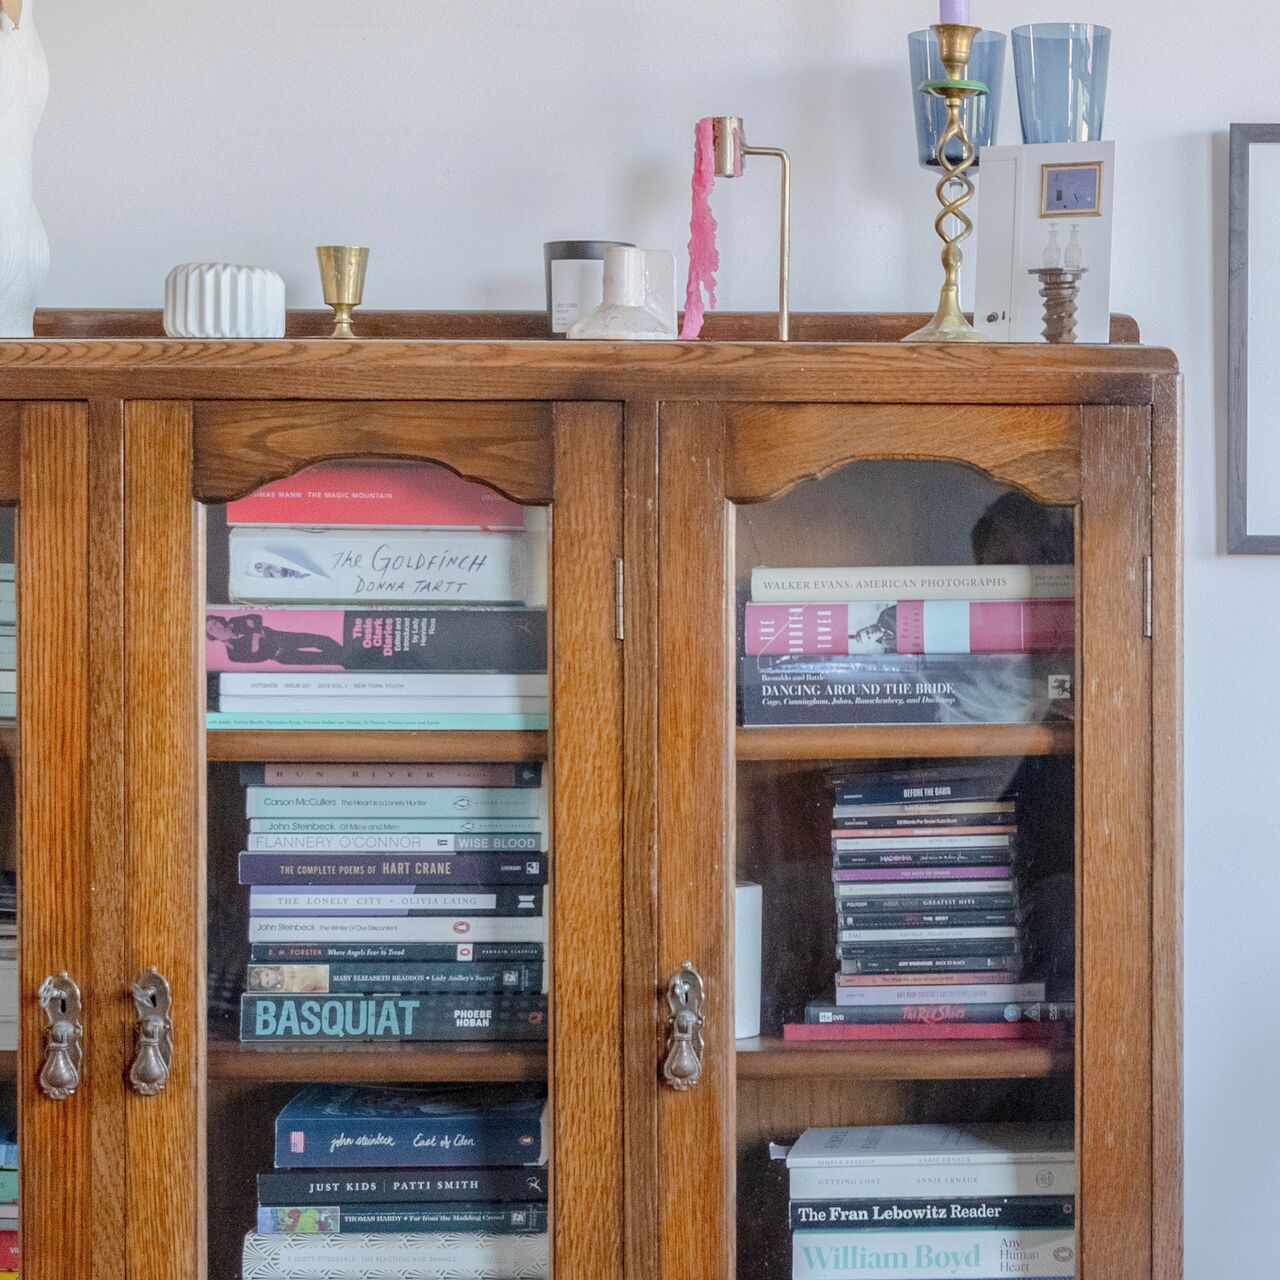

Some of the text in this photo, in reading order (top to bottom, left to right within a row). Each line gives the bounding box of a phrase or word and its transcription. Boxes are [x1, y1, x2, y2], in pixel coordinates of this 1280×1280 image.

[354, 575, 468, 594] DONNA TARTT
[763, 578, 1008, 590] WALKER EVANS: AMERICAN PHOTOGRAPHS
[762, 682, 956, 696] DANCING AROUND THE BRIDE
[904, 786, 952, 798] BEFORE THE DAWN
[264, 798, 337, 806] Carson McCullers
[268, 822, 290, 831] John
[292, 822, 335, 831] Steinbeck
[256, 836, 536, 848] FLANNERY O'CONNOR WISE BLOOD
[280, 862, 452, 874] THE COMPLETE POEMS OF HART CRANE
[401, 897, 438, 905] OLIVIA
[444, 897, 478, 905] LAING
[257, 924, 315, 932] John Steinbeck
[255, 1000, 420, 1038] BASQUIAT
[454, 1010, 492, 1018] PHOEBE
[456, 1018, 490, 1028] HOBAN
[309, 1180, 479, 1194] JUST KIDS PATTI SMITH
[798, 1204, 1002, 1222] The Fran Lebowitz Reader
[1000, 1238, 1022, 1249] Any
[802, 1243, 981, 1274] William Boyd
[1000, 1250, 1040, 1260] Human
[1000, 1262, 1030, 1272] Heart
